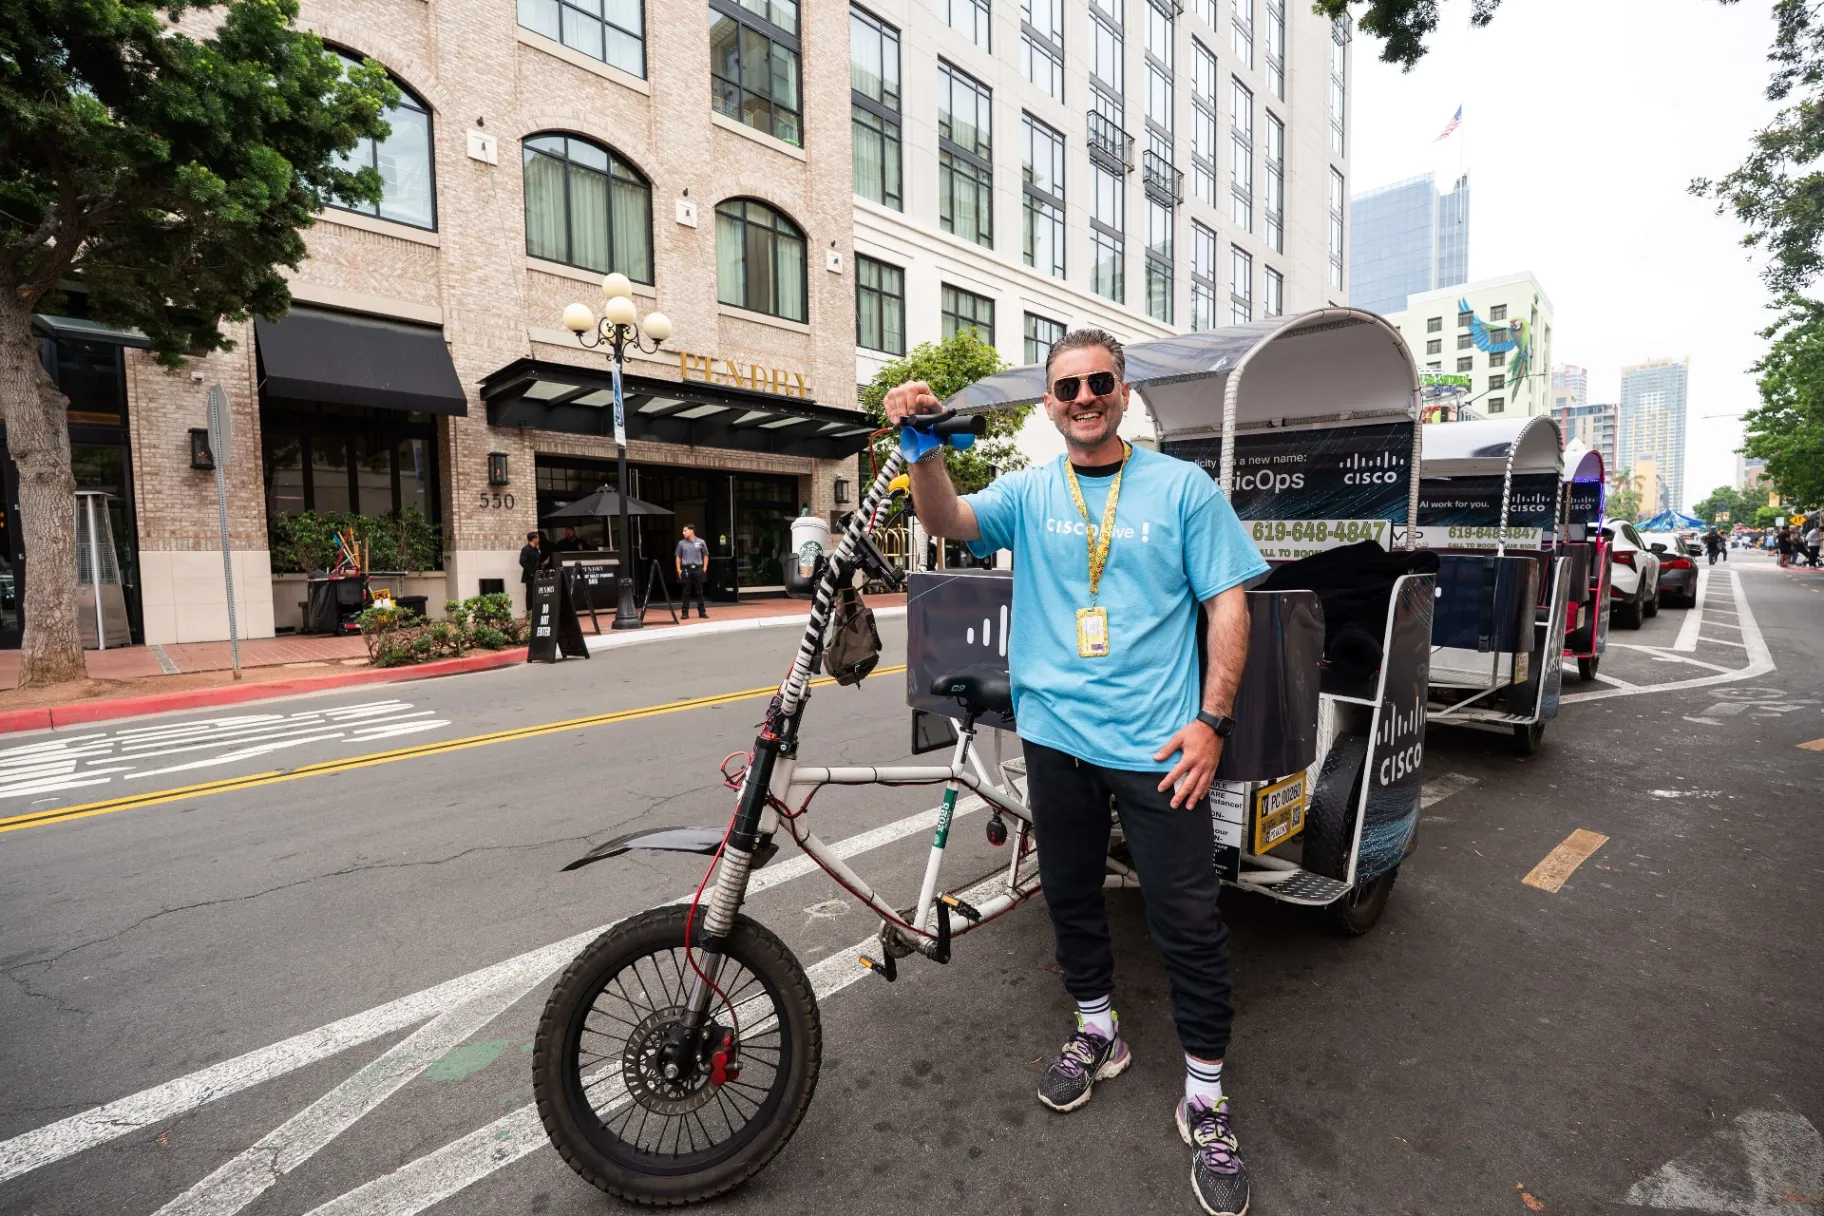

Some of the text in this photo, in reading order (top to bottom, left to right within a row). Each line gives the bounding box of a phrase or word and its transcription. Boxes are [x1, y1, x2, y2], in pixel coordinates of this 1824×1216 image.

[680, 351, 809, 398] PENDRY
[1239, 458, 1246, 466] a
[1248, 455, 1271, 465] new
[1273, 453, 1307, 464] name:
[1343, 471, 1398, 485] CISCO
[479, 492, 515, 510] 550
[1430, 500, 1453, 508] work
[1454, 500, 1468, 508] for
[1470, 501, 1490, 509] you.
[1510, 504, 1546, 512] CISCO
[1046, 518, 1099, 537] CISCO
[1252, 520, 1387, 543] 619-648-4847
[1448, 526, 1538, 539] 619-6484847
[1260, 548, 1276, 558] ALL
[1279, 548, 1292, 558] TO
[1380, 742, 1422, 786] CISCO
[1271, 794, 1281, 811] PC
